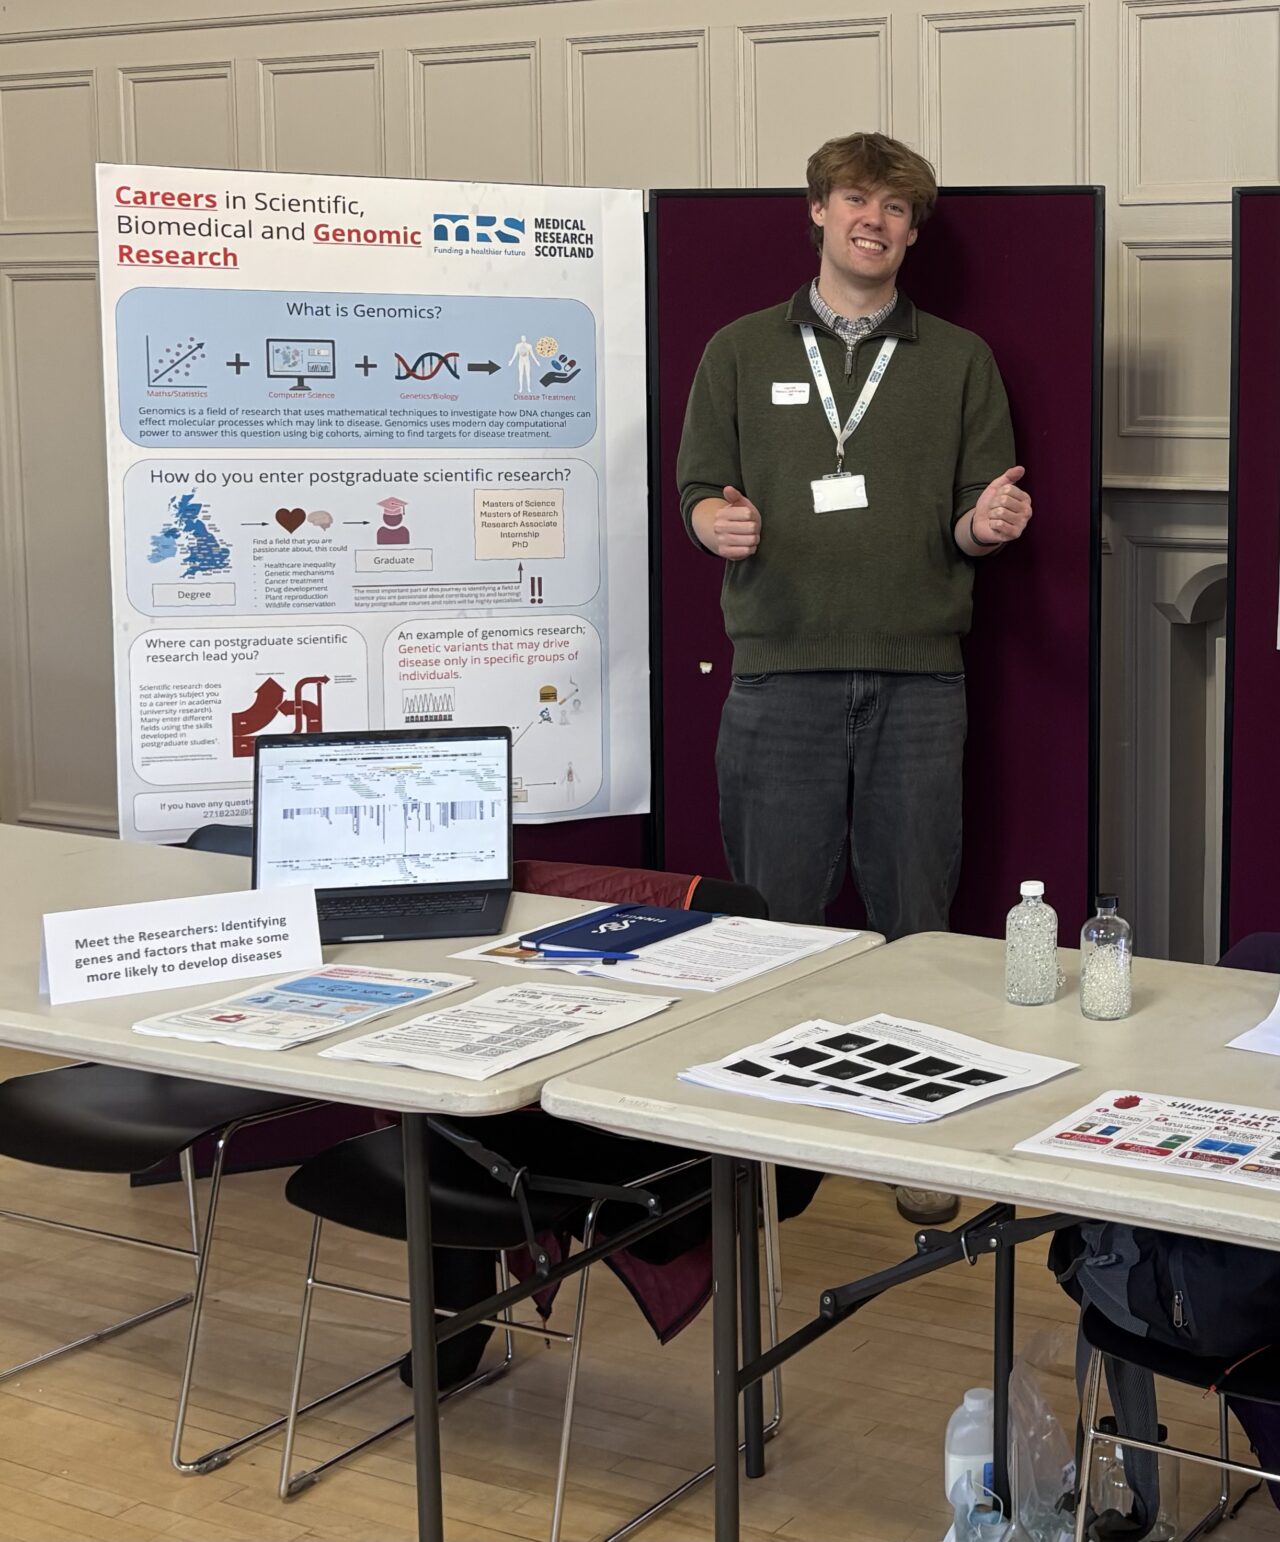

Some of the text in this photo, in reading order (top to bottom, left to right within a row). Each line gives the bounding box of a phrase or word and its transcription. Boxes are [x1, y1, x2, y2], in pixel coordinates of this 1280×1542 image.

[115, 185, 364, 217] Careers in Scientific,
[117, 215, 422, 245] Biomedical and Genomic
[534, 218, 586, 231] MEDICAL
[535, 232, 593, 245] RESEARCH
[118, 244, 238, 267] Research
[434, 247, 463, 256] Funding
[504, 248, 526, 256] future
[535, 246, 594, 259] SCOTLAND
[286, 302, 442, 320] What is Genomics?
[151, 468, 571, 487] How do you enter postgraduate scientific research?
[482, 500, 556, 508] Masters of Science
[480, 510, 558, 518] Masters of Research
[482, 520, 558, 529] Research Associate
[500, 531, 540, 539] Internship
[512, 541, 529, 549] PhD
[374, 556, 415, 566] Graduate
[178, 590, 212, 601] Degree
[398, 625, 586, 642] An example of genomics research;
[146, 634, 348, 650] Where can postgraduate scientific
[398, 639, 570, 654] Genetic variants that may drive
[146, 650, 259, 663] research lead you?
[398, 651, 579, 668] disease only in specific groups of
[399, 670, 462, 681] individuals.
[74, 916, 287, 950] Meet the Researchers: Identifying
[75, 932, 290, 969] genes and factors that make some
[86, 949, 283, 984] more likely to develop diseases
